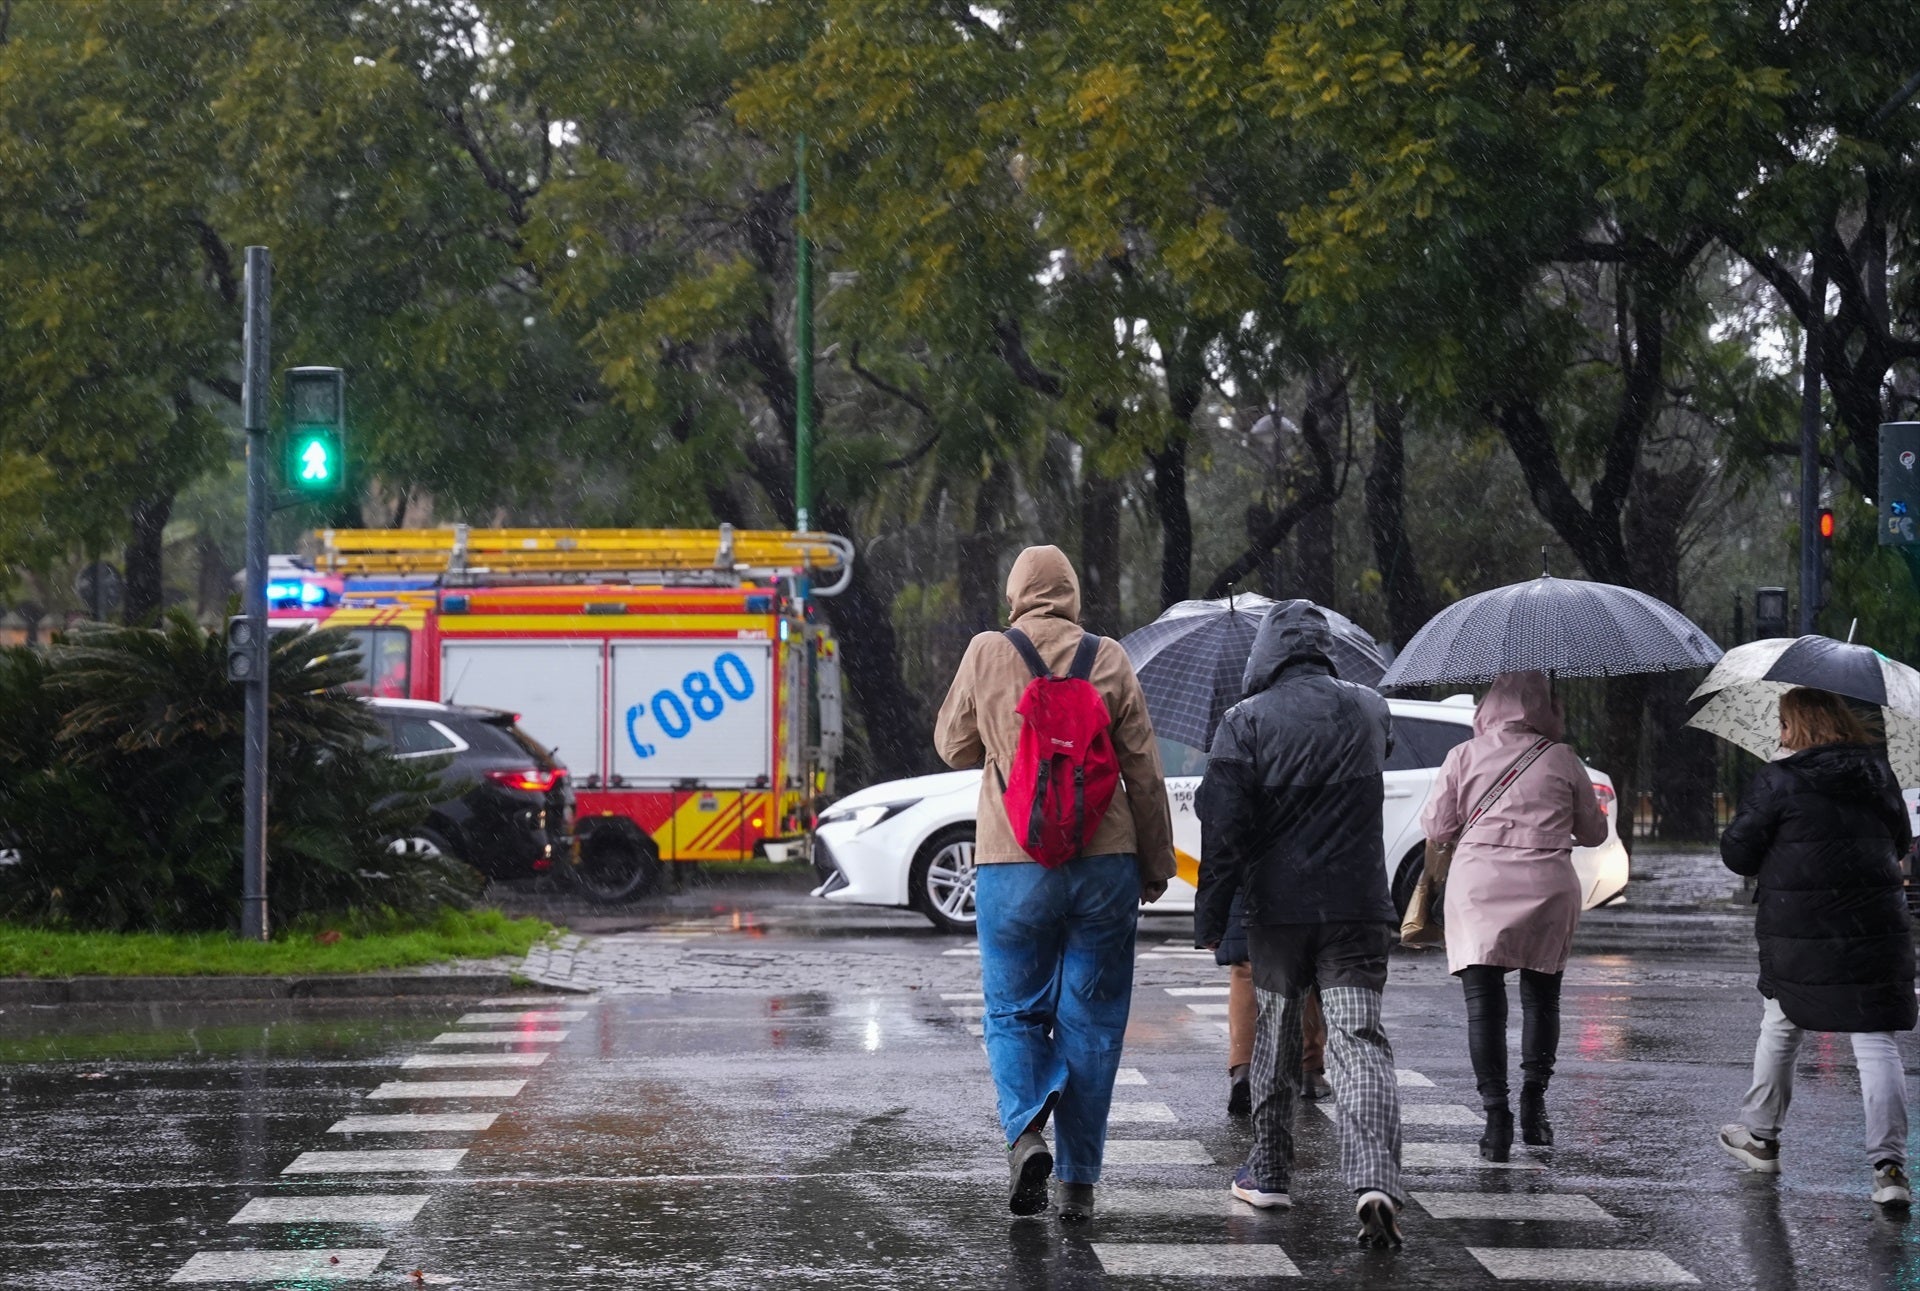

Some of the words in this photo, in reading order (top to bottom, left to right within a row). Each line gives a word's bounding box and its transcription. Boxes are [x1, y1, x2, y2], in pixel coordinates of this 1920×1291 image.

[651, 652, 754, 739] 080
[1174, 791, 1193, 801] 156
[1180, 802, 1189, 812] A
